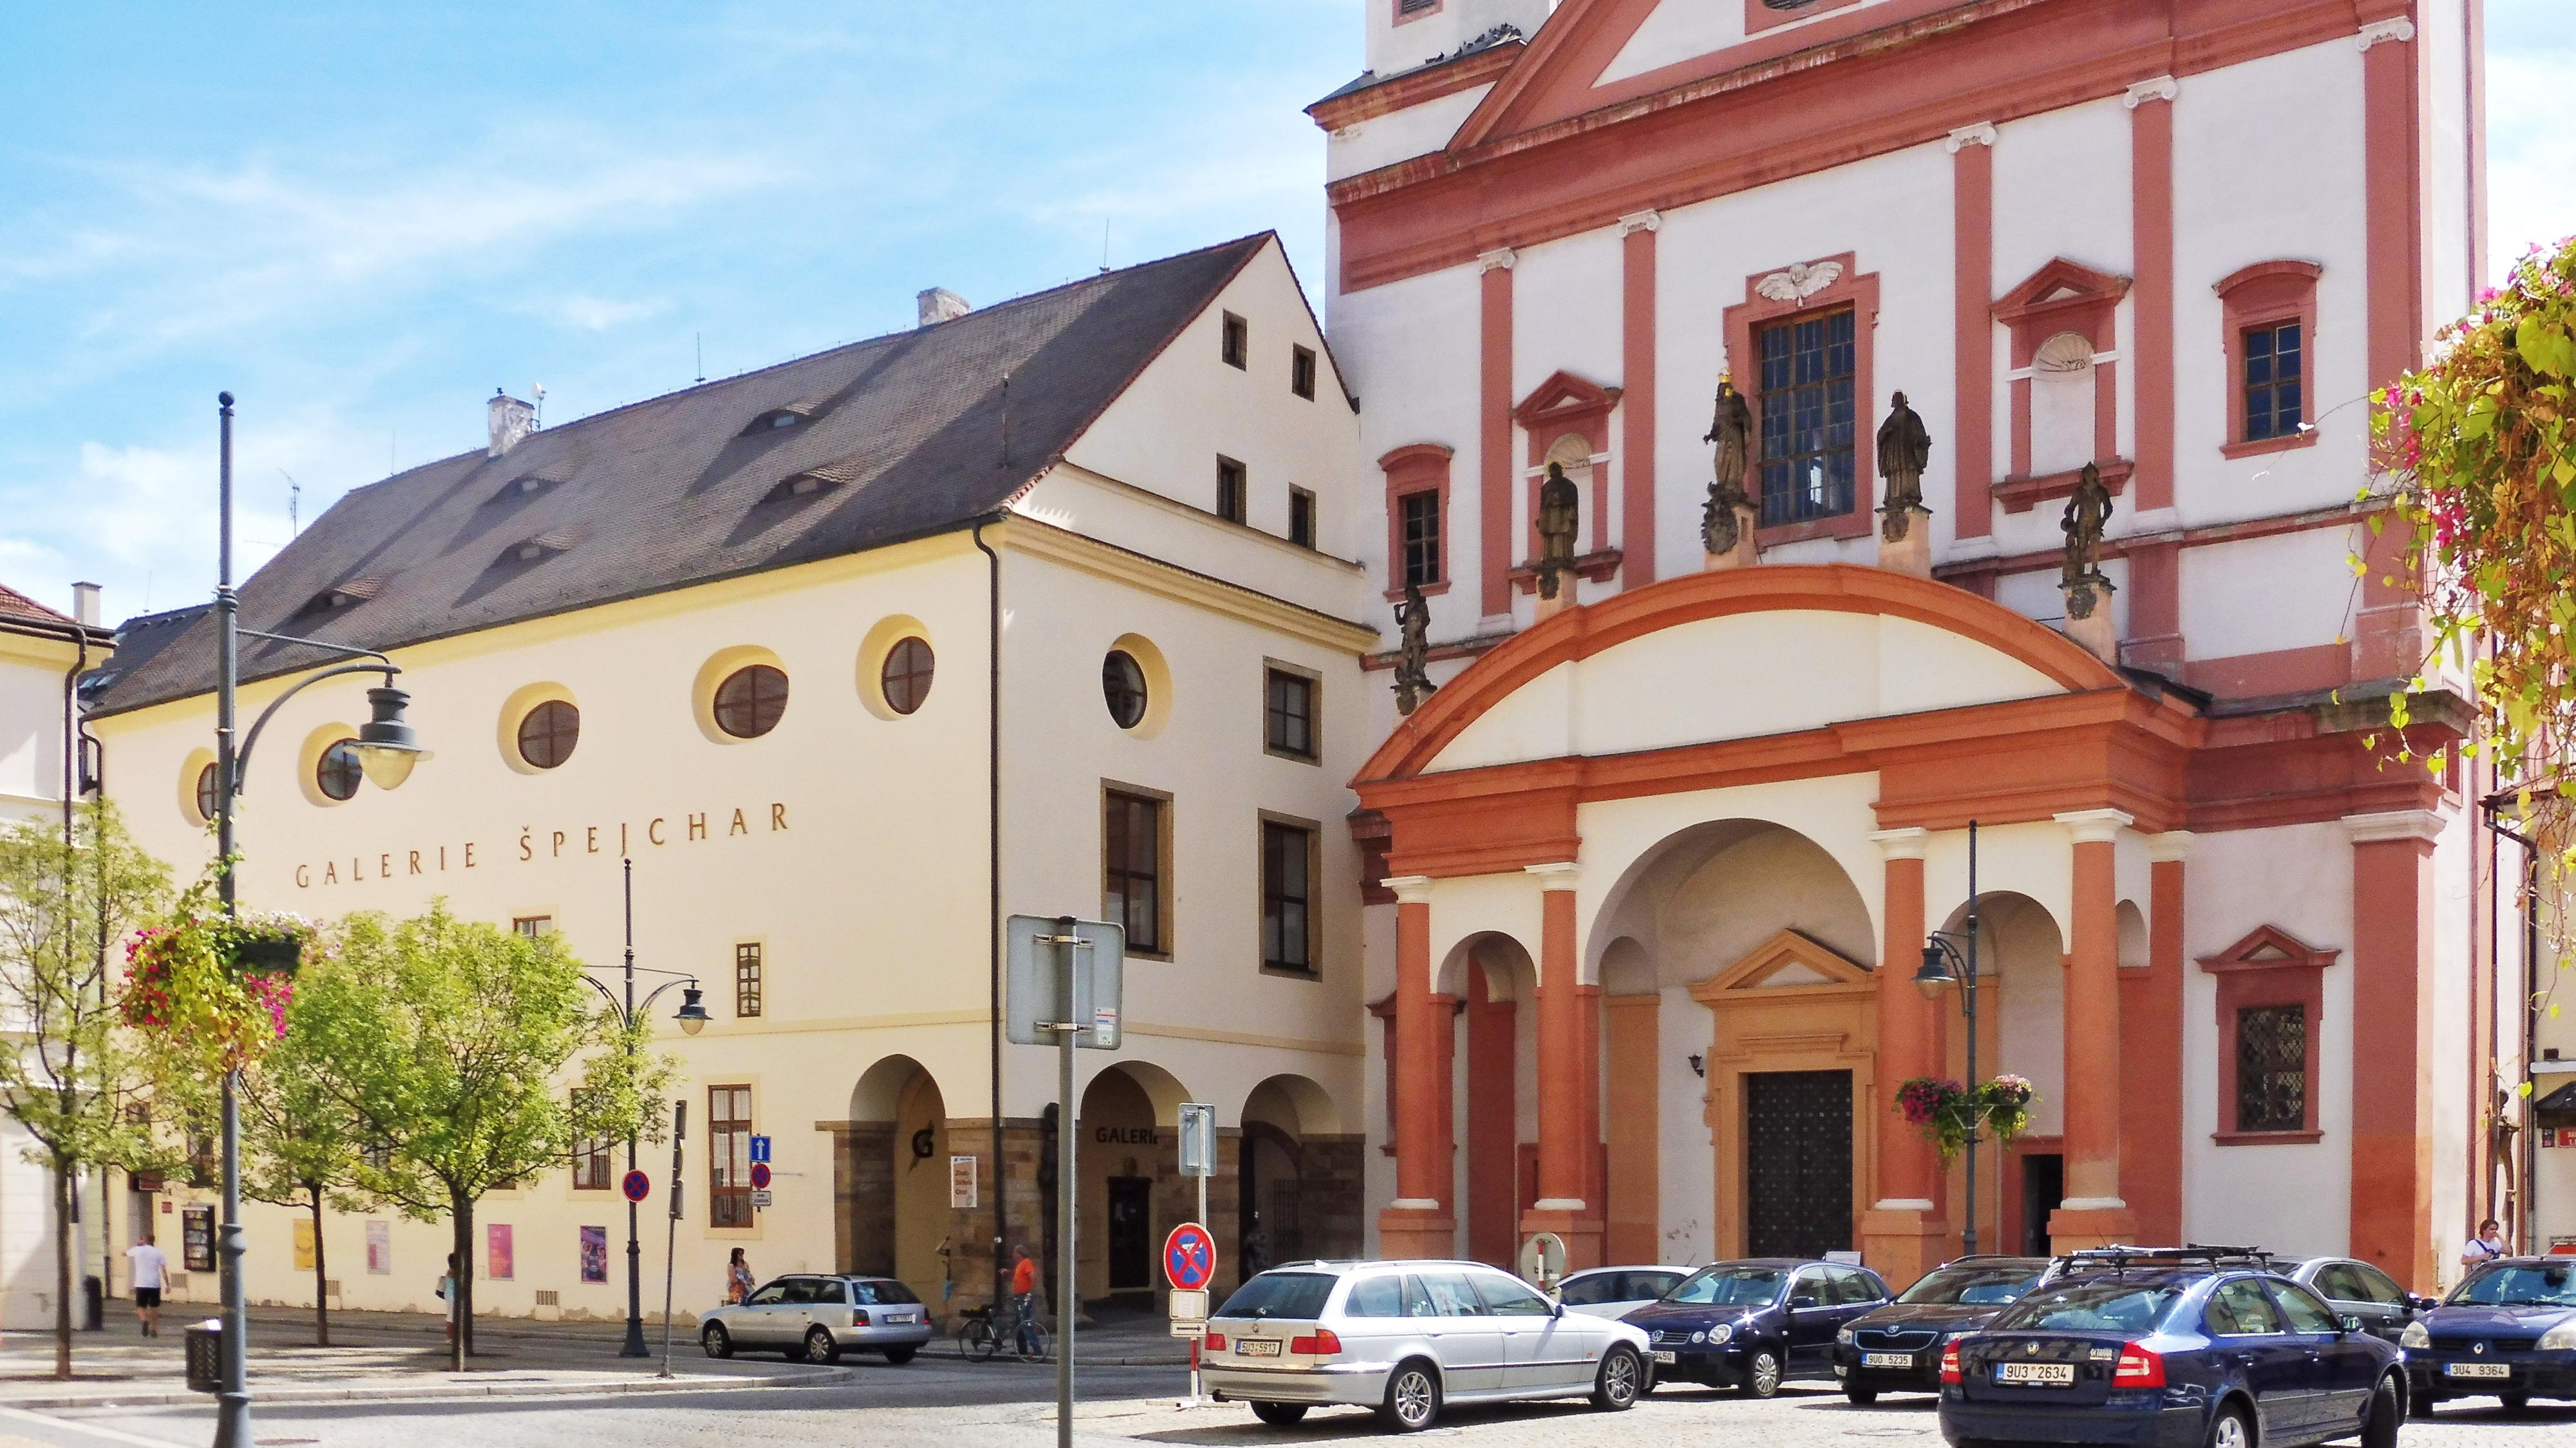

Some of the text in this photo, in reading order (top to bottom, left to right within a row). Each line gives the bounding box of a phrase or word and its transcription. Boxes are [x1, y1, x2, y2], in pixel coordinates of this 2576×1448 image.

[295, 802, 789, 889] GALERIE ŠPEJCHAR
[1888, 1355, 1908, 1364] 5235
[2007, 1365, 2067, 1379] 9U3 2634
[2452, 1365, 2504, 1375] 3U4 9364
